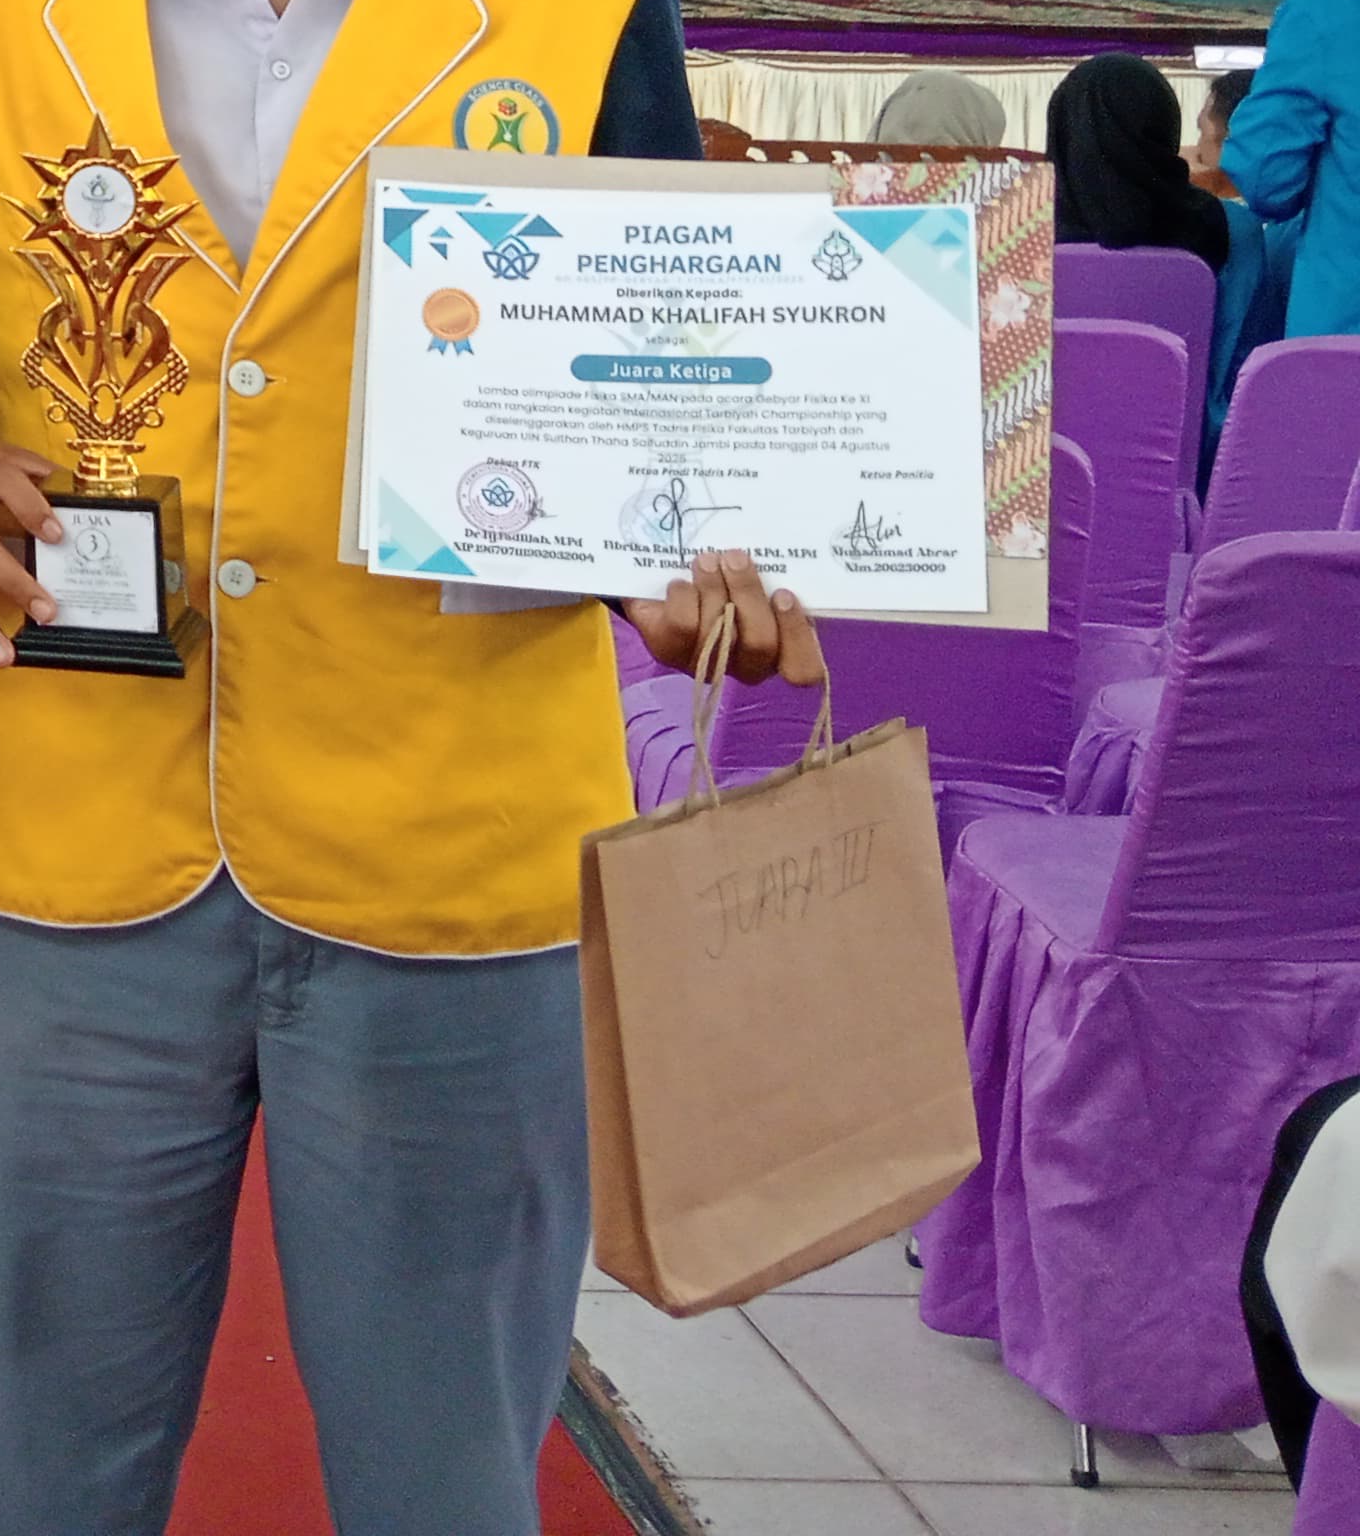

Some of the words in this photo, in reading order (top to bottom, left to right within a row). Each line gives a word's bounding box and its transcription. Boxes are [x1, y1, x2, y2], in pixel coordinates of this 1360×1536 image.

[624, 225, 733, 244] PIAGAM
[577, 254, 782, 274] PENGHARGAAN
[616, 288, 682, 298] Diberikan
[685, 289, 743, 301] Kepada:
[500, 303, 645, 324] MUHAMMAD
[651, 306, 765, 324] KHALIFAH
[773, 306, 886, 324] SYUKRON
[645, 336, 689, 346] sebagai
[610, 362, 664, 378] Juara
[670, 363, 733, 381] Ketiga
[478, 385, 519, 397] Lomba
[521, 388, 582, 402] olimpiade
[584, 390, 617, 401] Fisika
[619, 390, 678, 402] SMA/MAN
[681, 393, 713, 405] pada
[716, 395, 754, 404] acara
[755, 394, 801, 406] Gebyar
[804, 394, 838, 404] Fisika
[840, 394, 856, 404] Ke
[860, 394, 871, 404] XI
[463, 398, 502, 409] dalam
[504, 402, 566, 414] rangkaian
[568, 404, 621, 417] kegiatan
[705, 409, 759, 421] Tarbiyah
[761, 409, 853, 422] Championship
[855, 411, 887, 423] yang
[485, 415, 586, 430] diselenggarakan
[587, 422, 614, 431] oleh
[616, 423, 649, 432] HMPS
[652, 424, 689, 433] Tadris
[692, 424, 725, 434] Fisika
[728, 425, 779, 435] Fakultas
[782, 425, 836, 437] Tarbiyah
[839, 425, 864, 435] dan
[460, 428, 518, 441] Keguruan
[520, 431, 540, 442] UIN
[543, 433, 589, 445] Sulthan
[592, 436, 629, 447] Thaha
[632, 438, 689, 449] Saifuddin
[691, 439, 730, 449] Jambi
[733, 440, 767, 452] pada
[769, 440, 819, 453] tanggal
[821, 440, 837, 450] 04
[840, 440, 891, 453] Agustus
[521, 459, 541, 470] FTK
[629, 466, 660, 476] Ketua
[692, 467, 724, 478] Tadris
[727, 468, 759, 478] Fisika
[860, 470, 892, 480] Ketua
[894, 470, 935, 480] Panitia
[832, 546, 913, 558] Muhammad
[696, 846, 824, 960] JUARA
